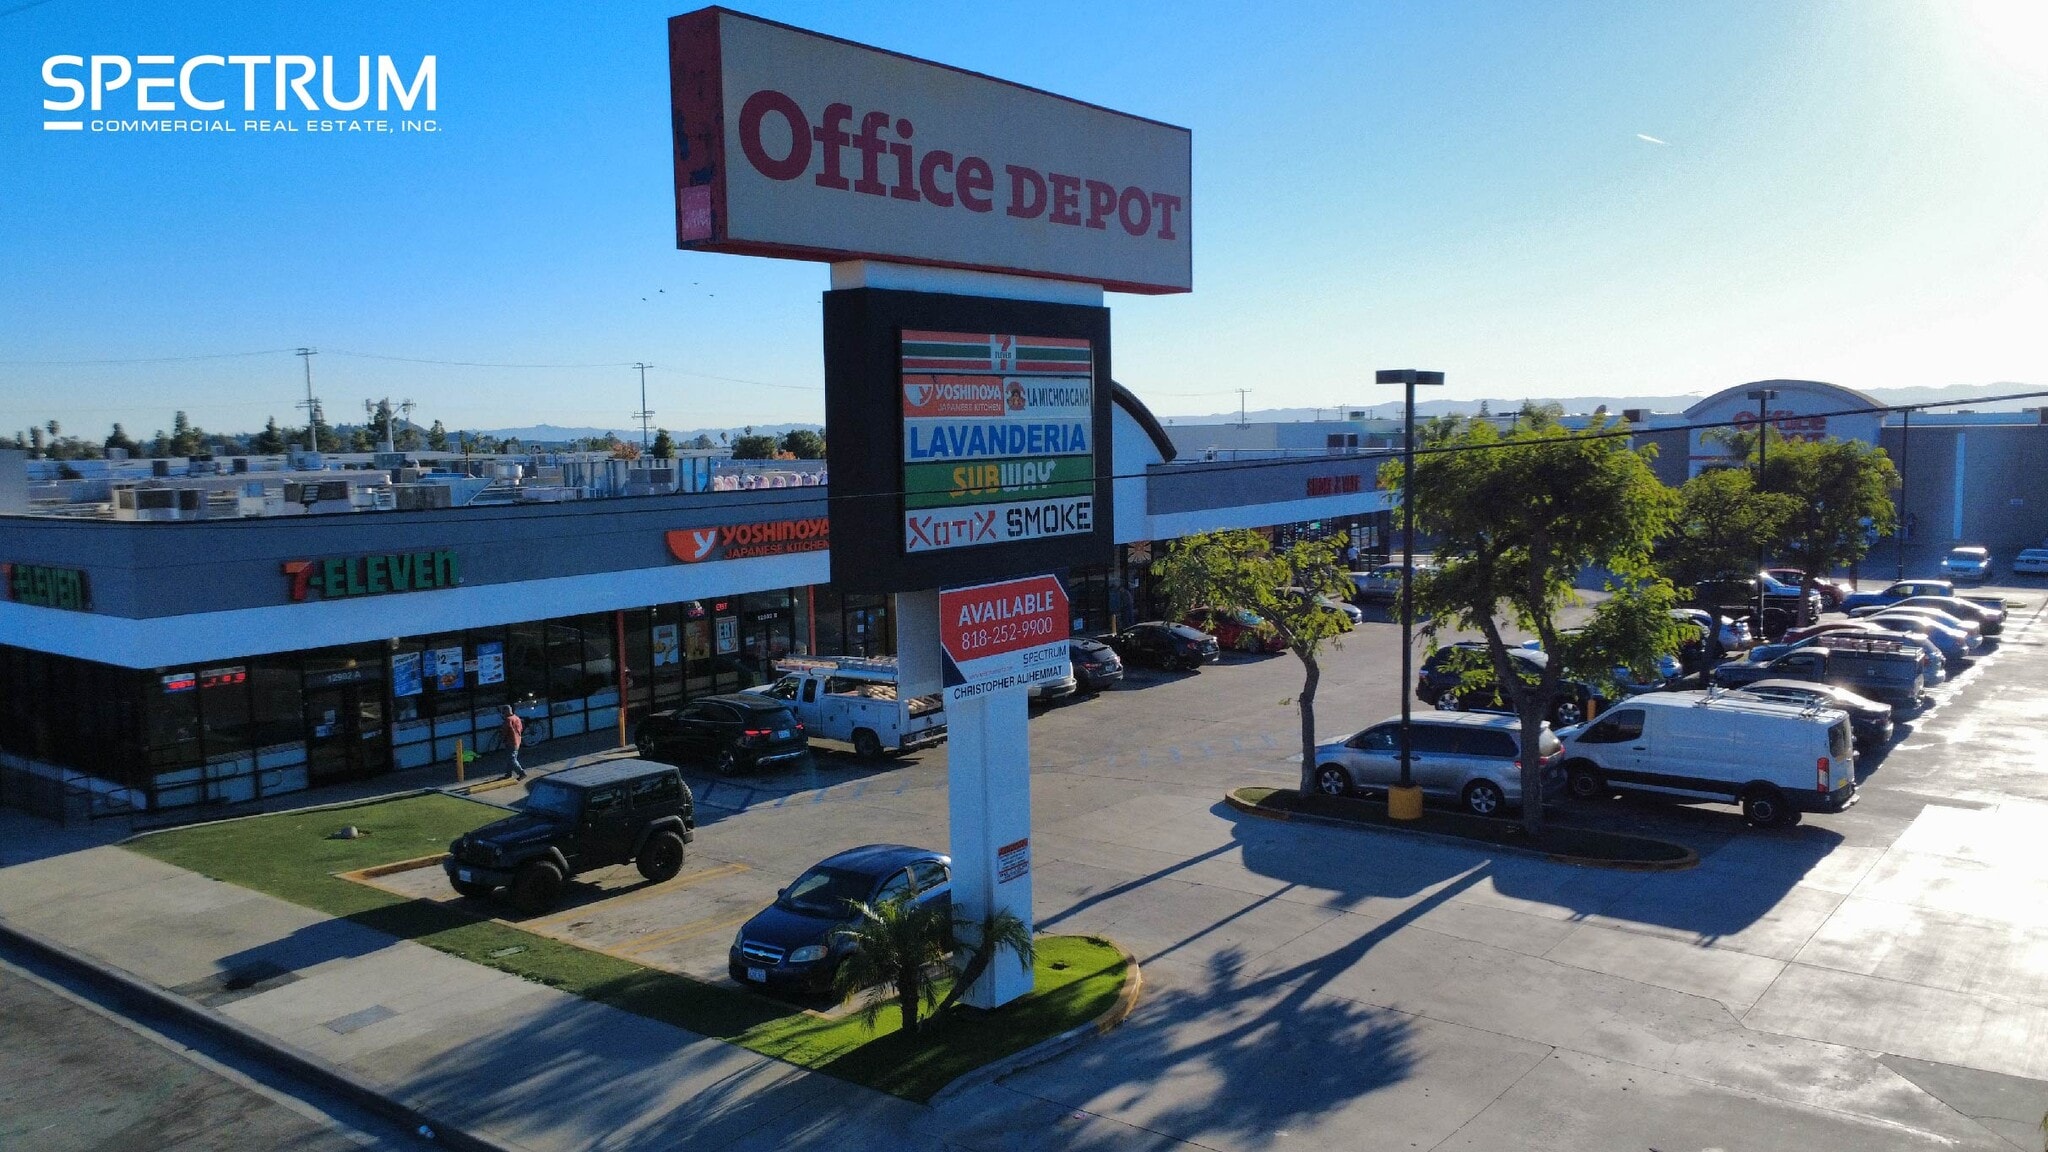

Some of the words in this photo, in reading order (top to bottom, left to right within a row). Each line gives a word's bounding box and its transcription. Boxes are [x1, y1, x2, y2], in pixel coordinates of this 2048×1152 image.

[739, 90, 994, 213] Office
[1005, 165, 1182, 240] DEPOT
[935, 383, 1002, 400] YOSHINOYA
[938, 403, 973, 412] JAPANESE
[975, 402, 1002, 411] KITCHEN
[1027, 387, 1038, 406] LA
[1039, 387, 1090, 407] MICHOACANA
[910, 423, 1087, 459] LAVANDERIA
[950, 460, 1056, 498] SUBWAY
[909, 509, 998, 549] XOTIX
[1006, 501, 1091, 537] SMOKE
[725, 544, 784, 560] JAPANESE
[958, 590, 1054, 627] AVAILABLE
[961, 616, 1053, 650] 818-252-9900
[1023, 645, 1068, 665] SPECTRUM
[953, 676, 1015, 700] CHRISTOPHER
[1017, 665, 1063, 685] ALIHEMMAT
